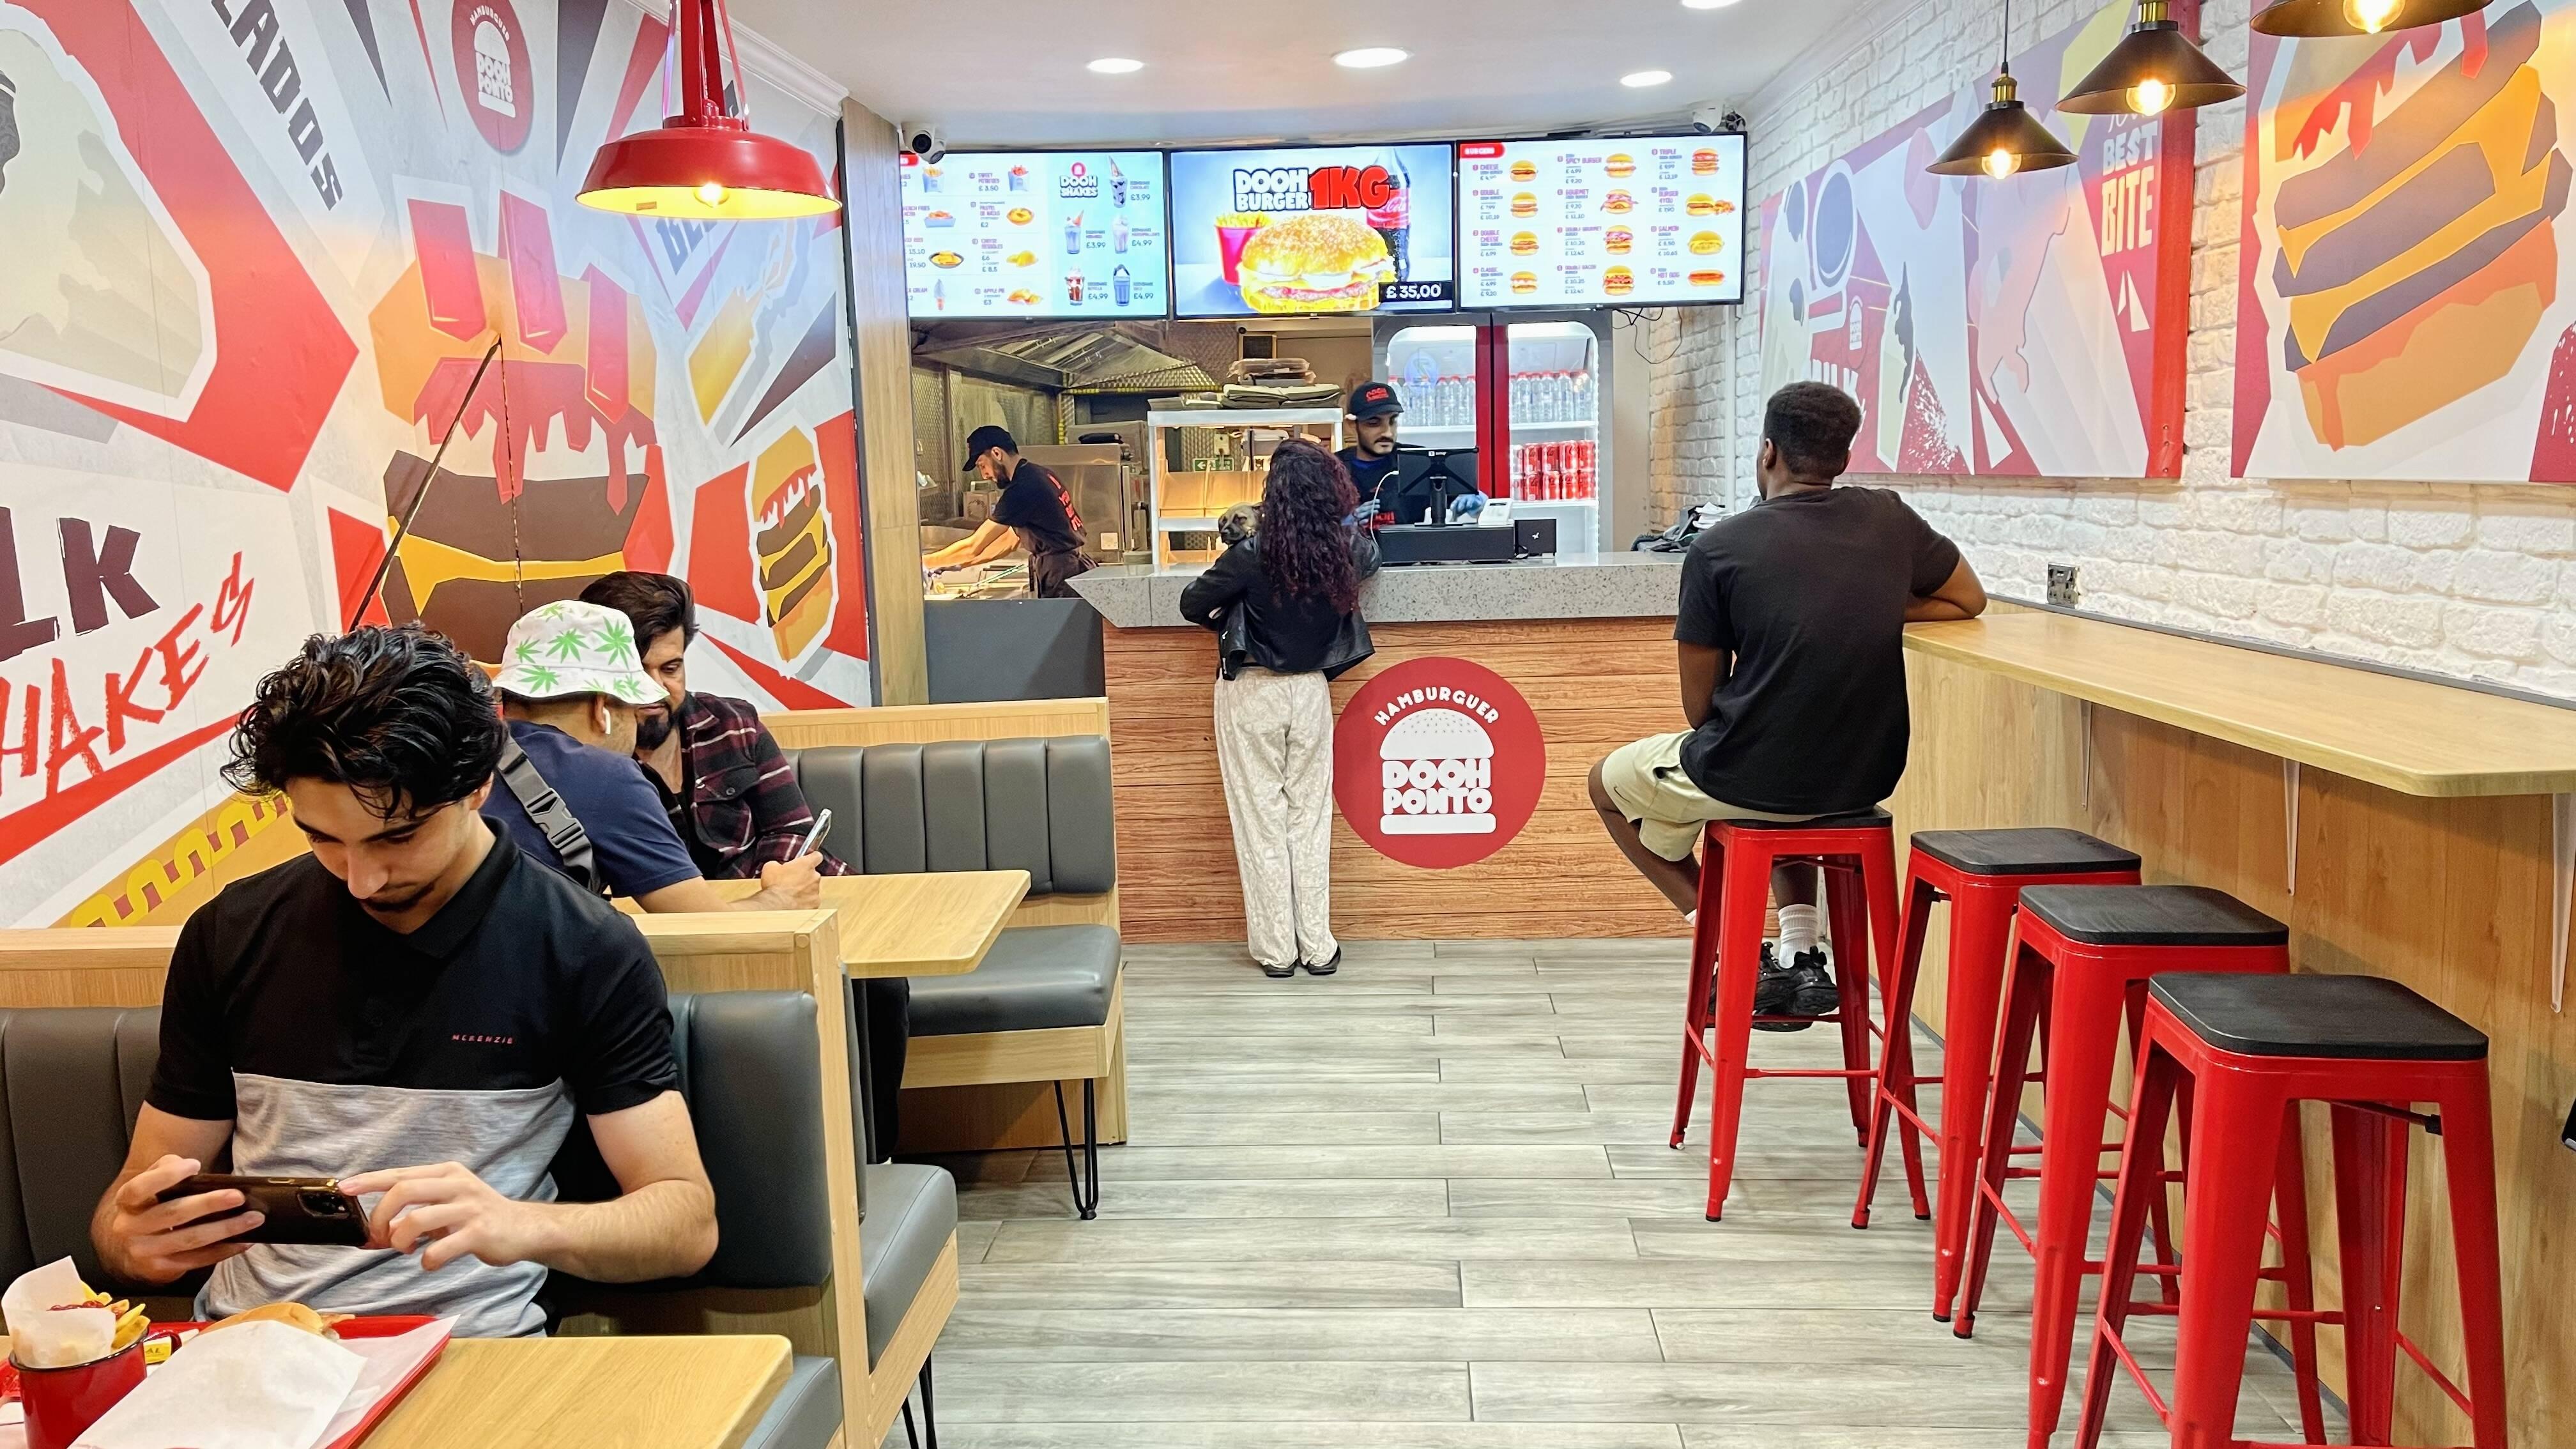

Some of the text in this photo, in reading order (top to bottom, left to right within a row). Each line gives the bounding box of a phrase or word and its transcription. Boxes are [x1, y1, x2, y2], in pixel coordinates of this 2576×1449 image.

[475, 52, 511, 86] DOOH
[478, 75, 513, 103] PONTO
[2103, 121, 2158, 176] BEST
[1059, 175, 1098, 188] DOOH
[1060, 187, 1098, 197] SHAKES
[1234, 166, 1390, 210] DOOH 1KG
[1235, 192, 1310, 211] BURGER
[2101, 165, 2154, 257] BITE
[1386, 284, 1441, 299] £ 35,00
[1374, 686, 1499, 726] HAMBURGUER
[1382, 758, 1491, 790] DOOH
[1383, 786, 1493, 815] PONTO
[451, 1034, 514, 1045] MCKENZIE
